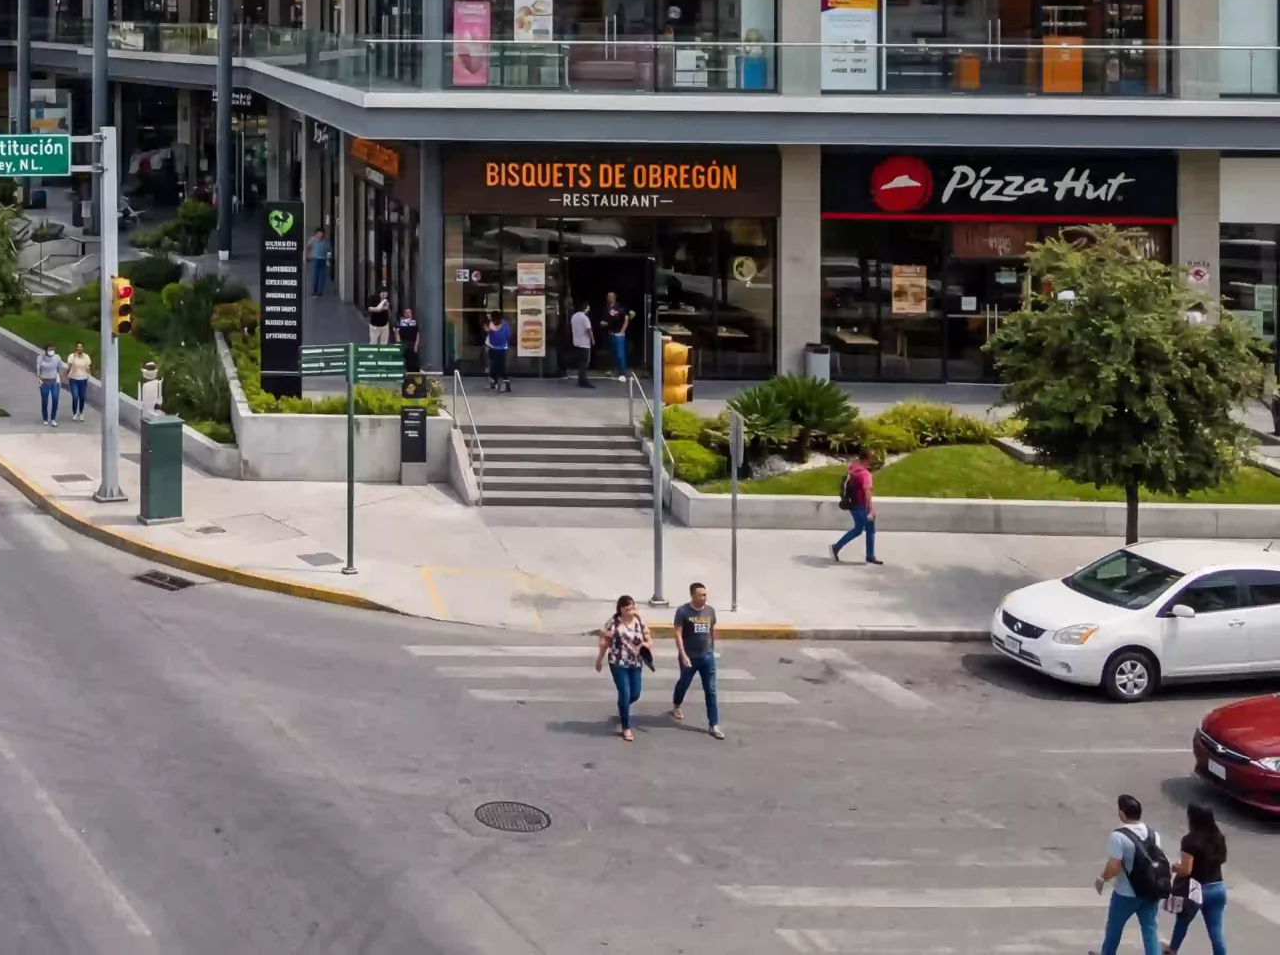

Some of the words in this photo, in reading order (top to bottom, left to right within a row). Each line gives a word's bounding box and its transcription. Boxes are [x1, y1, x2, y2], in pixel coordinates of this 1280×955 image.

[486, 162, 592, 188] BISQUETS
[599, 163, 627, 188] DE
[633, 160, 737, 190] OBREGÓN
[941, 165, 1049, 204] Pizza
[1053, 167, 1136, 202] Hut
[563, 193, 659, 208] RESTAURANT
